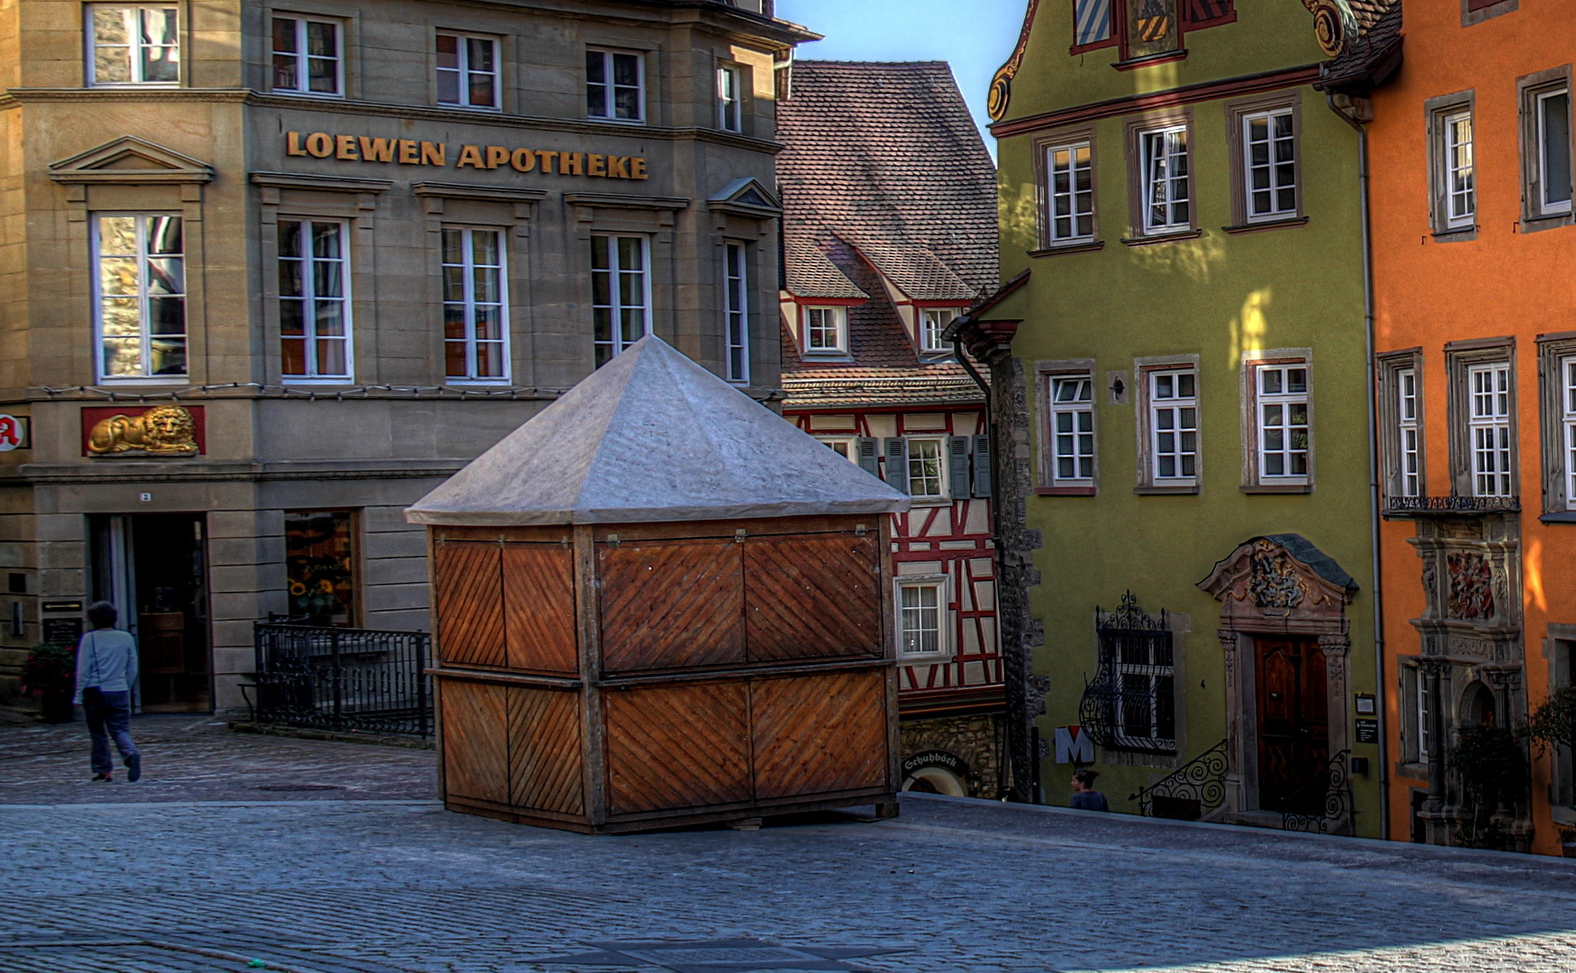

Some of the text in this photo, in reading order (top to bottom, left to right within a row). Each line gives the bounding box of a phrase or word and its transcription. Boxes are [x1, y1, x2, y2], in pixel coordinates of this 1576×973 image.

[286, 130, 650, 181] LOEWEN APOTHEKE
[1055, 726, 1095, 765] M
